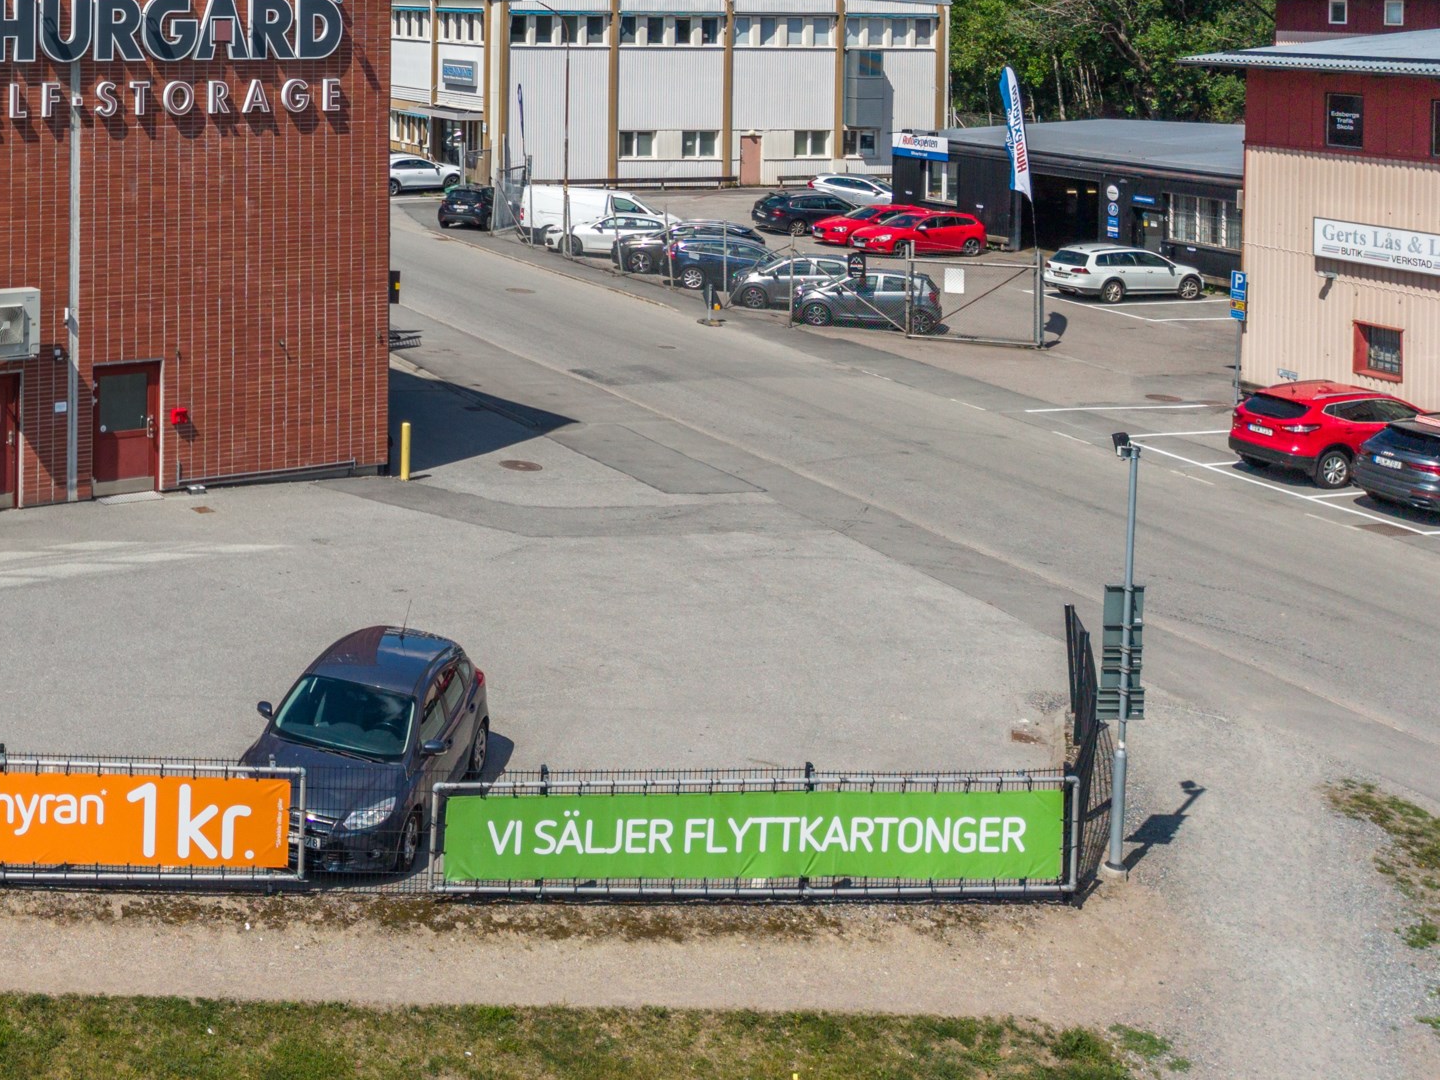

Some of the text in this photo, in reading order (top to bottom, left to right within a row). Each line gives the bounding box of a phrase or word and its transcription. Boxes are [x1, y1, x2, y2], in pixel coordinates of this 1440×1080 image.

[1330, 110, 1360, 119] Edsbergs
[1322, 223, 1367, 246] Gerts
[1372, 230, 1401, 251] Lås
[1407, 236, 1422, 254] &
[1340, 246, 1433, 269] BUTIK VERKSTAD
[1234, 273, 1244, 289] P
[126, 781, 156, 858] 1
[176, 783, 255, 860] kr.
[486, 809, 1027, 856] VI SÄLJER FLYTTKARTONGER
